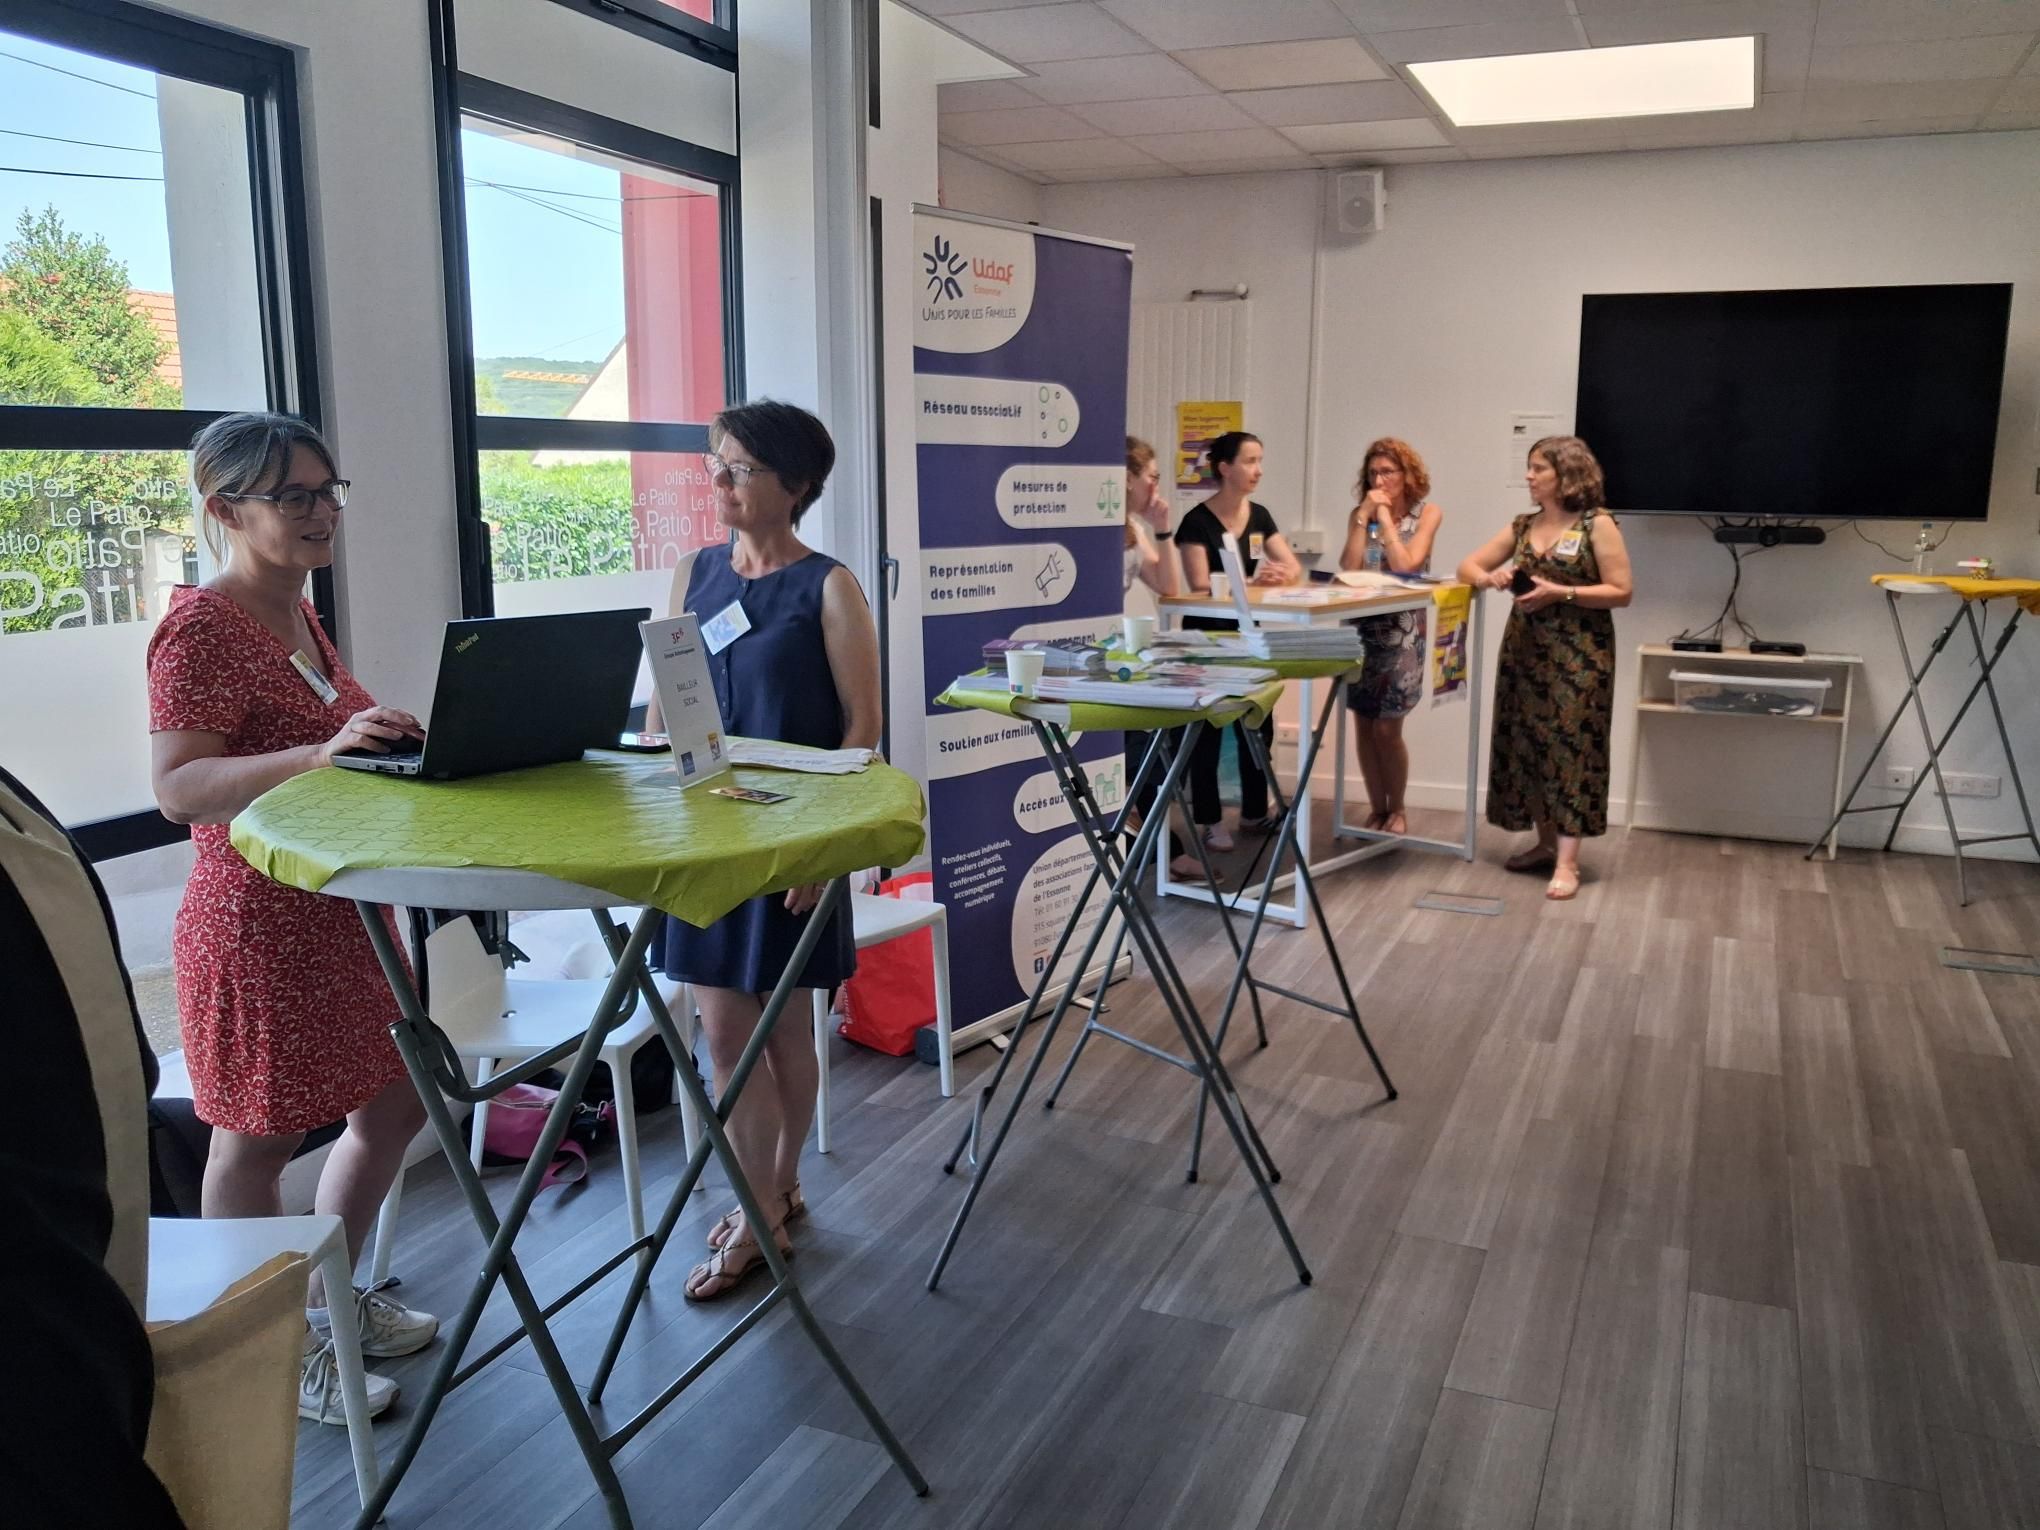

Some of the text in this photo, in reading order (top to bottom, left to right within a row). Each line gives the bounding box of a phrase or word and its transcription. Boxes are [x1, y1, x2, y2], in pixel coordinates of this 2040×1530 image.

[972, 257, 1015, 285] Udaf
[923, 400, 1022, 418] Réseau associatif
[1013, 481, 1068, 493] Mesures de
[631, 487, 679, 507] Le Patio
[690, 494, 705, 512] Le
[50, 499, 151, 527] Le Patio
[1013, 503, 1067, 515] protection
[646, 509, 692, 538] Patio
[0, 527, 41, 556] atio
[516, 519, 572, 553] Patio
[929, 561, 1014, 579] Représentation
[930, 585, 996, 600] des familles
[939, 724, 1036, 753] Soutien aux famille
[1019, 794, 1065, 814] Accès aux
[942, 849, 981, 866] Rendez-vous
[1033, 862, 1052, 874] Union
[1033, 879, 1045, 889] des
[1045, 867, 1082, 884] associations
[1033, 892, 1042, 903] de
